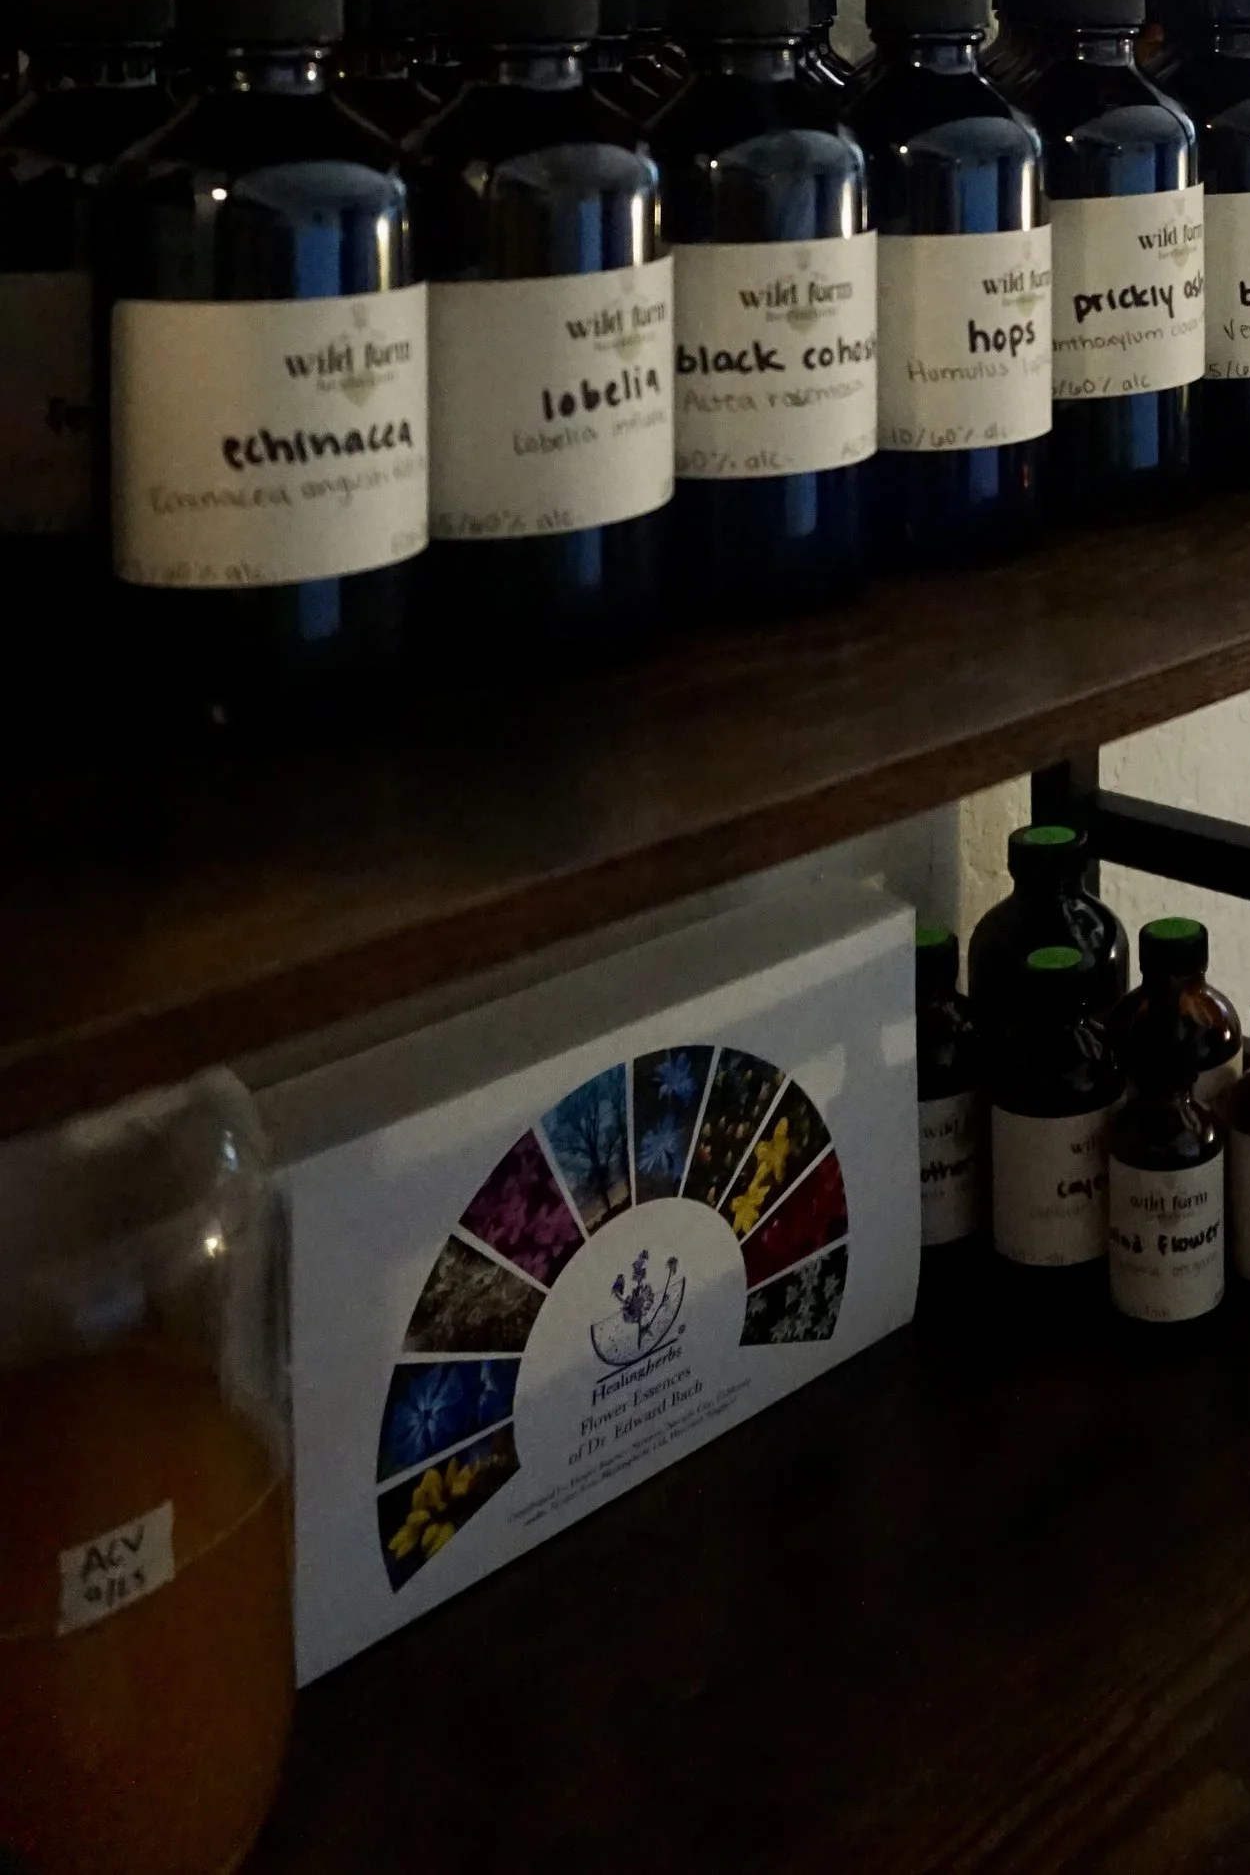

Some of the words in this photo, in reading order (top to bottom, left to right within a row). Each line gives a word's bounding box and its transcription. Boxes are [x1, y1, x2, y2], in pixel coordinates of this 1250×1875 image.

[1137, 223, 1179, 251] wild
[737, 277, 800, 311] wild
[982, 271, 1025, 297] wild
[1073, 282, 1175, 325] prickly
[564, 307, 624, 341] wild
[966, 317, 1037, 358] hops
[283, 338, 355, 380] wild
[674, 338, 787, 376] black
[541, 364, 663, 423] lobelia
[1121, 373, 1152, 392] alc
[1130, 1189, 1165, 1211] wild
[590, 1343, 683, 1407] Healingherbs
[580, 1401, 627, 1438] Flower
[633, 1366, 692, 1408] Essences
[568, 1441, 586, 1466] of
[614, 1397, 667, 1440] Edward
[671, 1378, 703, 1407] Bach
